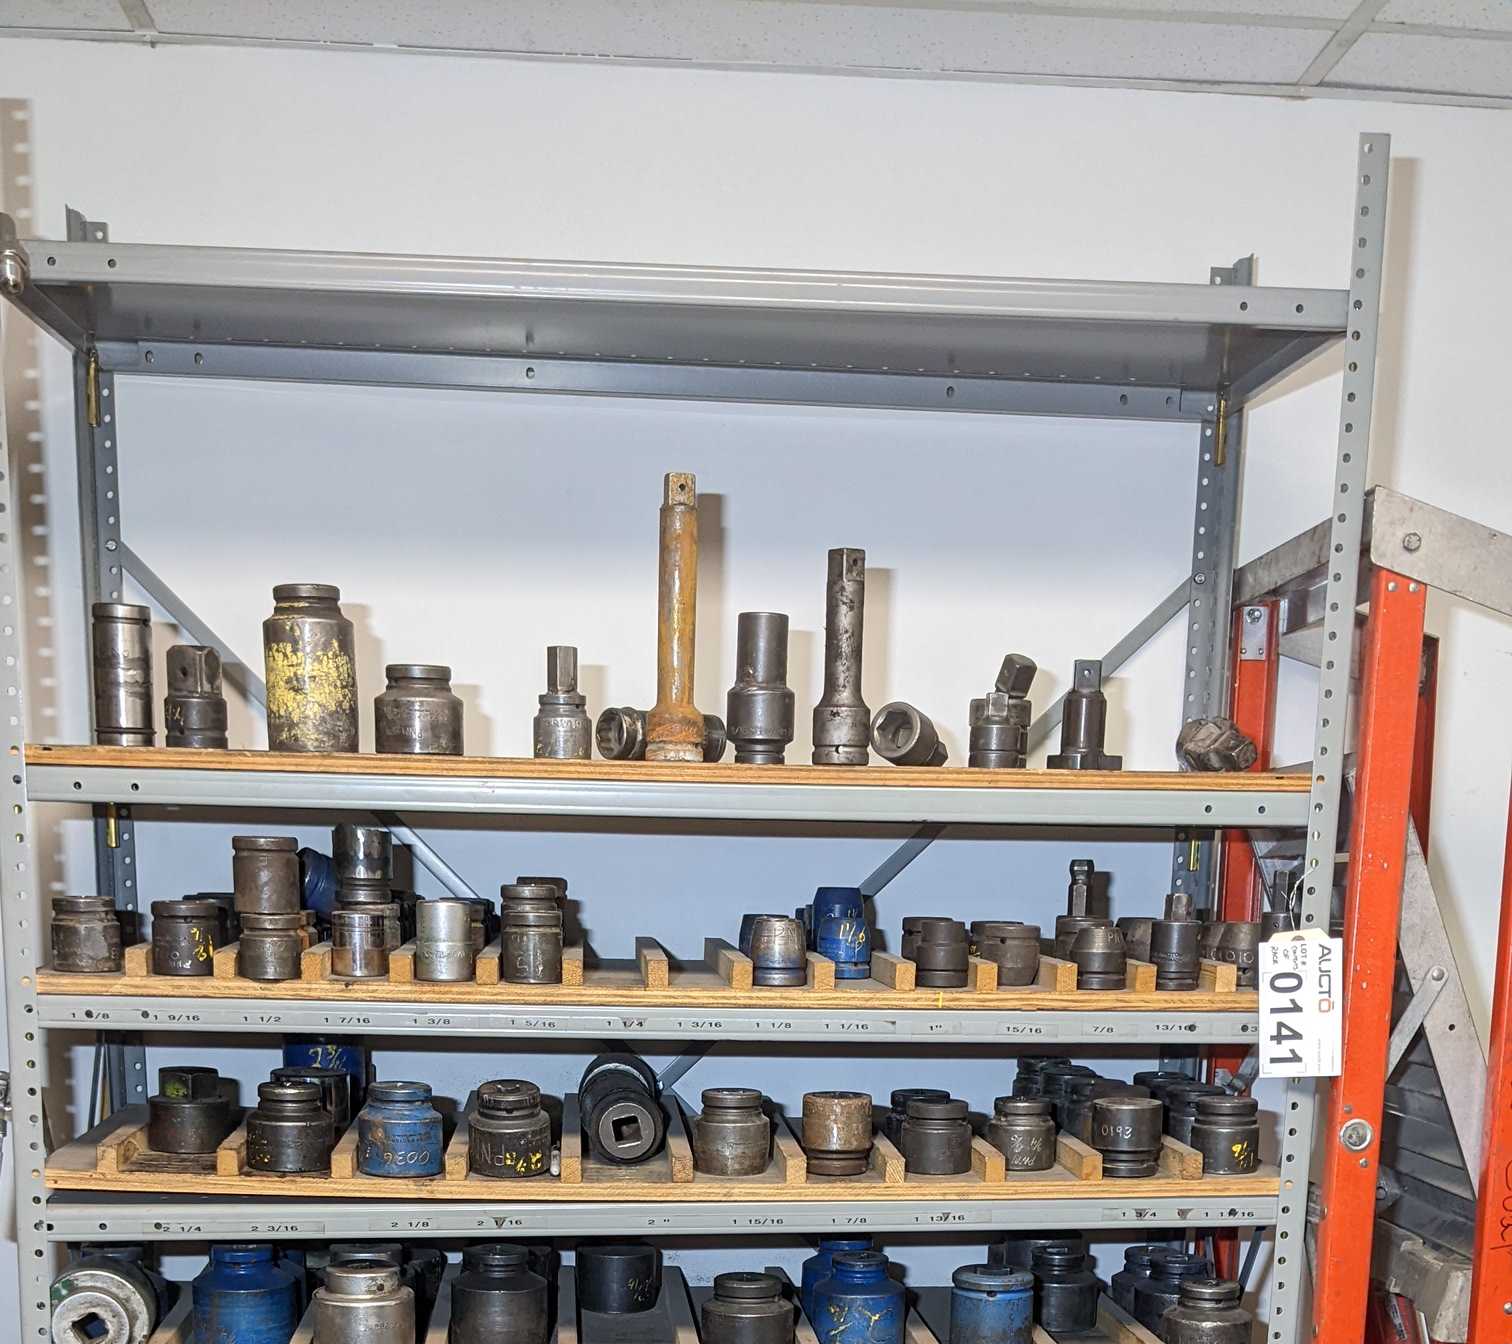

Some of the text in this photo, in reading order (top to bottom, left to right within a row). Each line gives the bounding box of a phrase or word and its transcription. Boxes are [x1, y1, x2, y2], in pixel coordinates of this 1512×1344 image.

[168, 1014, 200, 1022] 9/16
[259, 1015, 282, 1023] 1/2
[339, 1016, 371, 1024] 7/16
[427, 1017, 451, 1025] 3/8
[1269, 972, 1304, 1064] 0141
[524, 1020, 556, 1028] 5/16
[622, 1020, 644, 1028] 1/4
[691, 1020, 723, 1028] 3/16
[771, 1021, 792, 1029] 1/8
[840, 1022, 869, 1031] 1/16
[1005, 1025, 1043, 1034] 15/16
[1092, 1025, 1114, 1033] 7/8
[1219, 1209, 1255, 1218] 1/16
[407, 1219, 431, 1229] 1/8
[748, 1218, 784, 1226] 15/16
[177, 1223, 202, 1233] 1/4
[267, 1223, 299, 1233] 3/16
